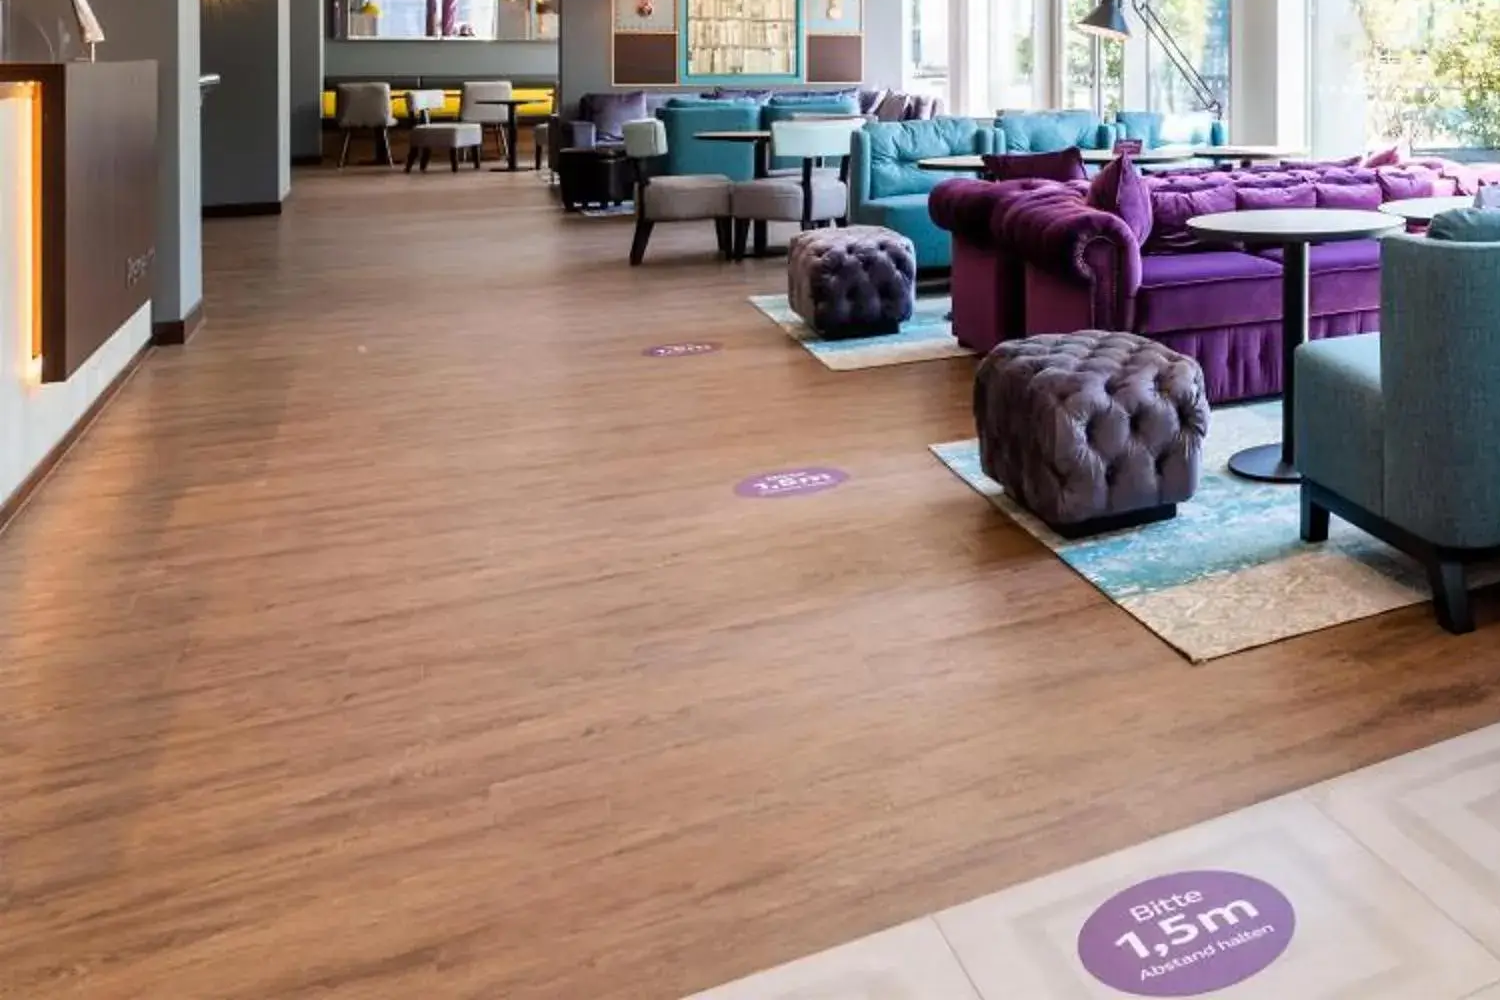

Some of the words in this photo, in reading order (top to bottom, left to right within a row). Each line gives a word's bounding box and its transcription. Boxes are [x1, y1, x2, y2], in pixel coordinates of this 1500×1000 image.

[1114, 899, 1260, 959] 1,5m
[1129, 889, 1203, 923] Bitte
[1139, 944, 1216, 981] Abstand
[1216, 922, 1275, 951] halten
